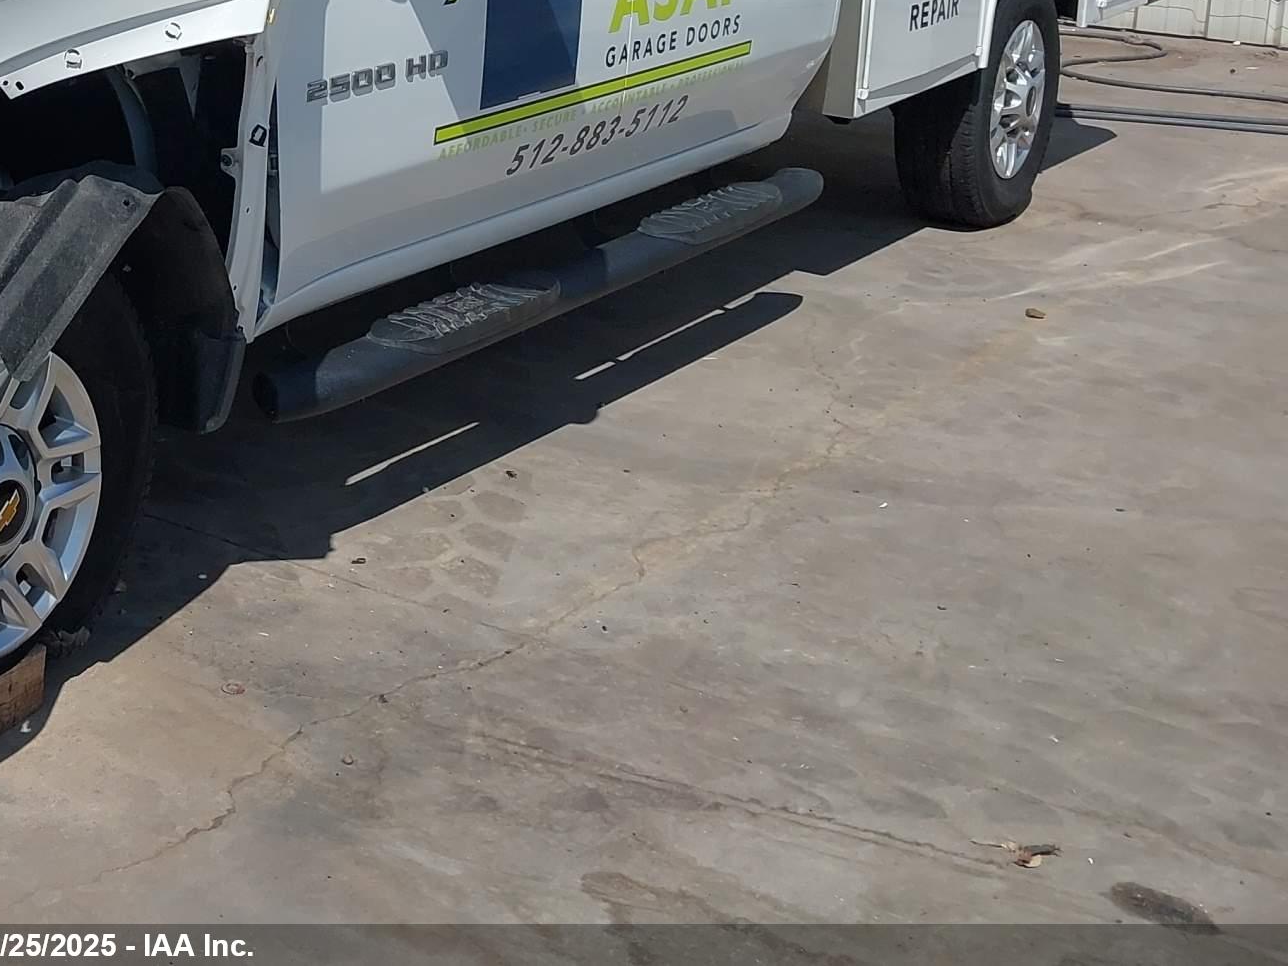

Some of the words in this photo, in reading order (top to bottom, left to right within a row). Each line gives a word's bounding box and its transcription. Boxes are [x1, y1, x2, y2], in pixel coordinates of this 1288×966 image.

[605, 30, 678, 68] GARAGE
[686, 14, 741, 47] DOORS
[306, 63, 396, 103] 2500
[406, 50, 449, 82] HD
[439, 124, 523, 161] AFFORDABLE
[529, 110, 578, 132] SECURE
[506, 94, 689, 176] 512-883-5112
